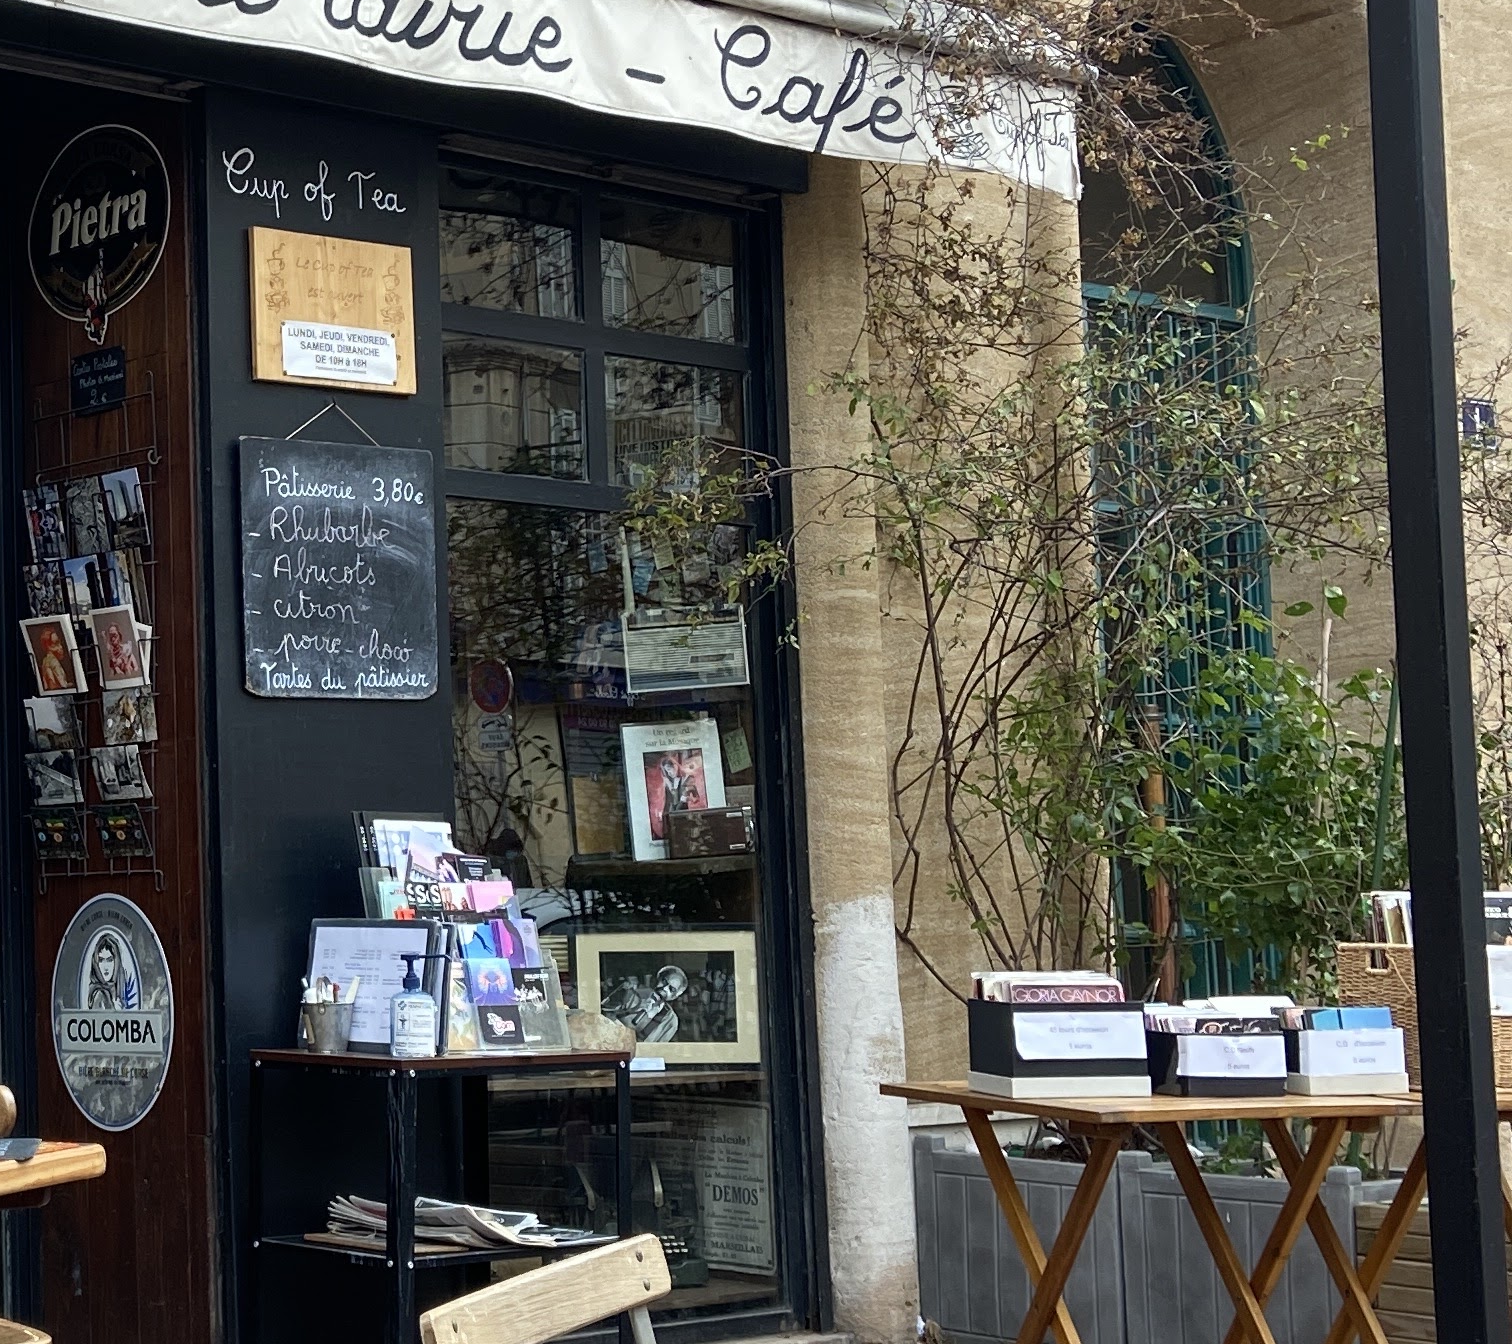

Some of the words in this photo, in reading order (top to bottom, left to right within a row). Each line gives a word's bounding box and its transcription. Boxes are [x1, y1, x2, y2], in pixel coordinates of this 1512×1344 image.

[715, 25, 916, 169] Café
[222, 147, 289, 218] Cup
[304, 160, 336, 221] of
[348, 171, 406, 213] Tea
[48, 188, 148, 257] Pietra
[287, 327, 317, 340] LUNDI,
[319, 330, 345, 343] JEUDI,
[347, 333, 390, 347] VENDREDI,
[300, 340, 335, 354] SAMEDI,
[337, 343, 380, 357] DIMANCHE
[315, 354, 327, 364] DE
[329, 356, 344, 366] 10H
[345, 357, 351, 367] à
[260, 465, 356, 500] Pâtisserie
[270, 503, 394, 548] Rhubarbe
[274, 549, 376, 586] Abricots
[260, 662, 312, 690] Tartes
[321, 668, 346, 690] du
[354, 666, 429, 698] pâtissier
[1014, 988, 1059, 1003] GLORIA
[1059, 988, 1117, 1003] GAYNOR
[66, 1017, 156, 1045] COLOMBA
